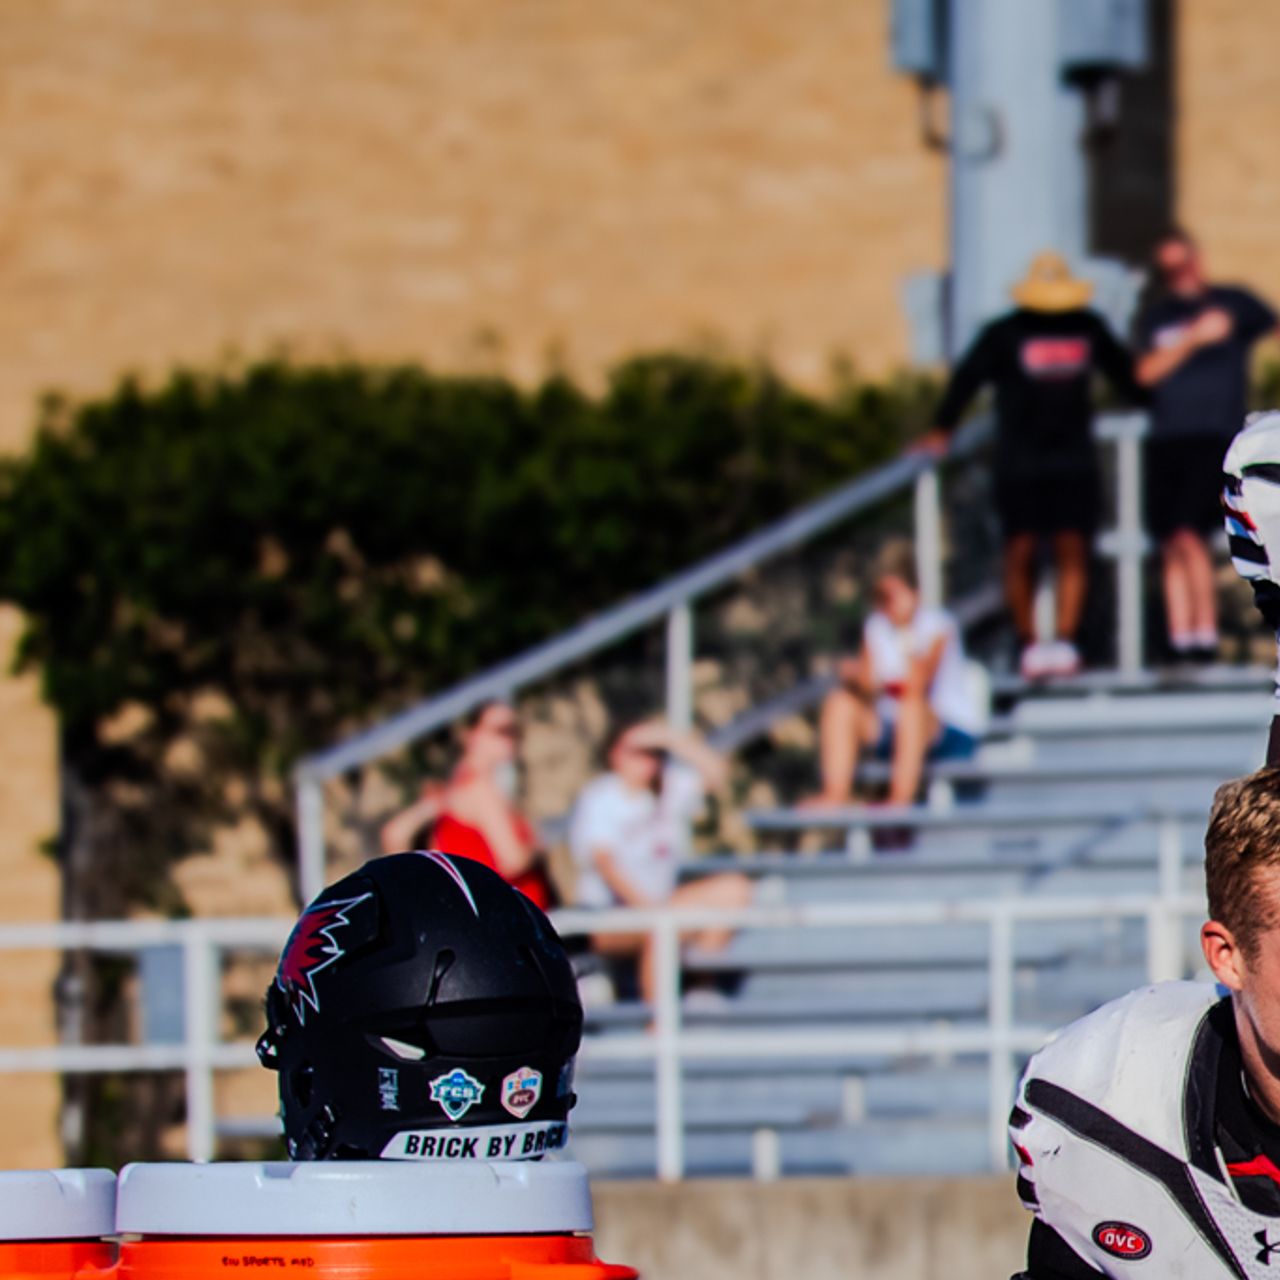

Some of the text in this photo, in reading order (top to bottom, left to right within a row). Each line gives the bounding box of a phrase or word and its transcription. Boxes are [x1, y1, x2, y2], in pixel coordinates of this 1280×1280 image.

[404, 1134, 479, 1158] BRICK
[486, 1134, 516, 1157] BY
[242, 1256, 286, 1268] SPORTS
